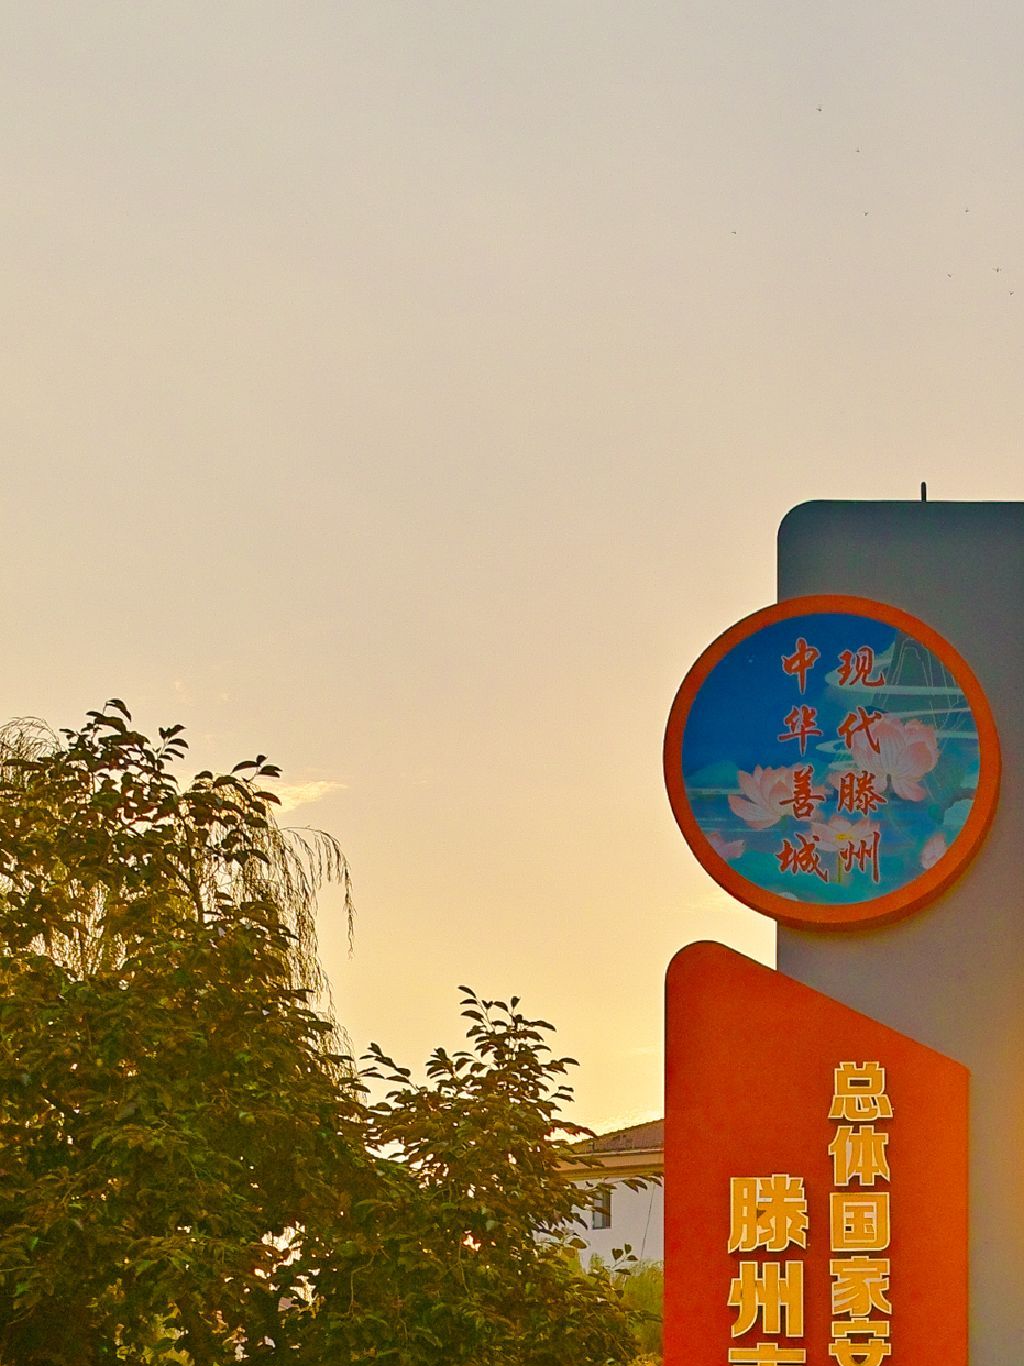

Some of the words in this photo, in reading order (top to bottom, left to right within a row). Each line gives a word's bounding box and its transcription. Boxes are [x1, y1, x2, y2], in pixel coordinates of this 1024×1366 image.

[776, 637, 829, 883] 中华善城
[837, 646, 887, 883] 现代滕州
